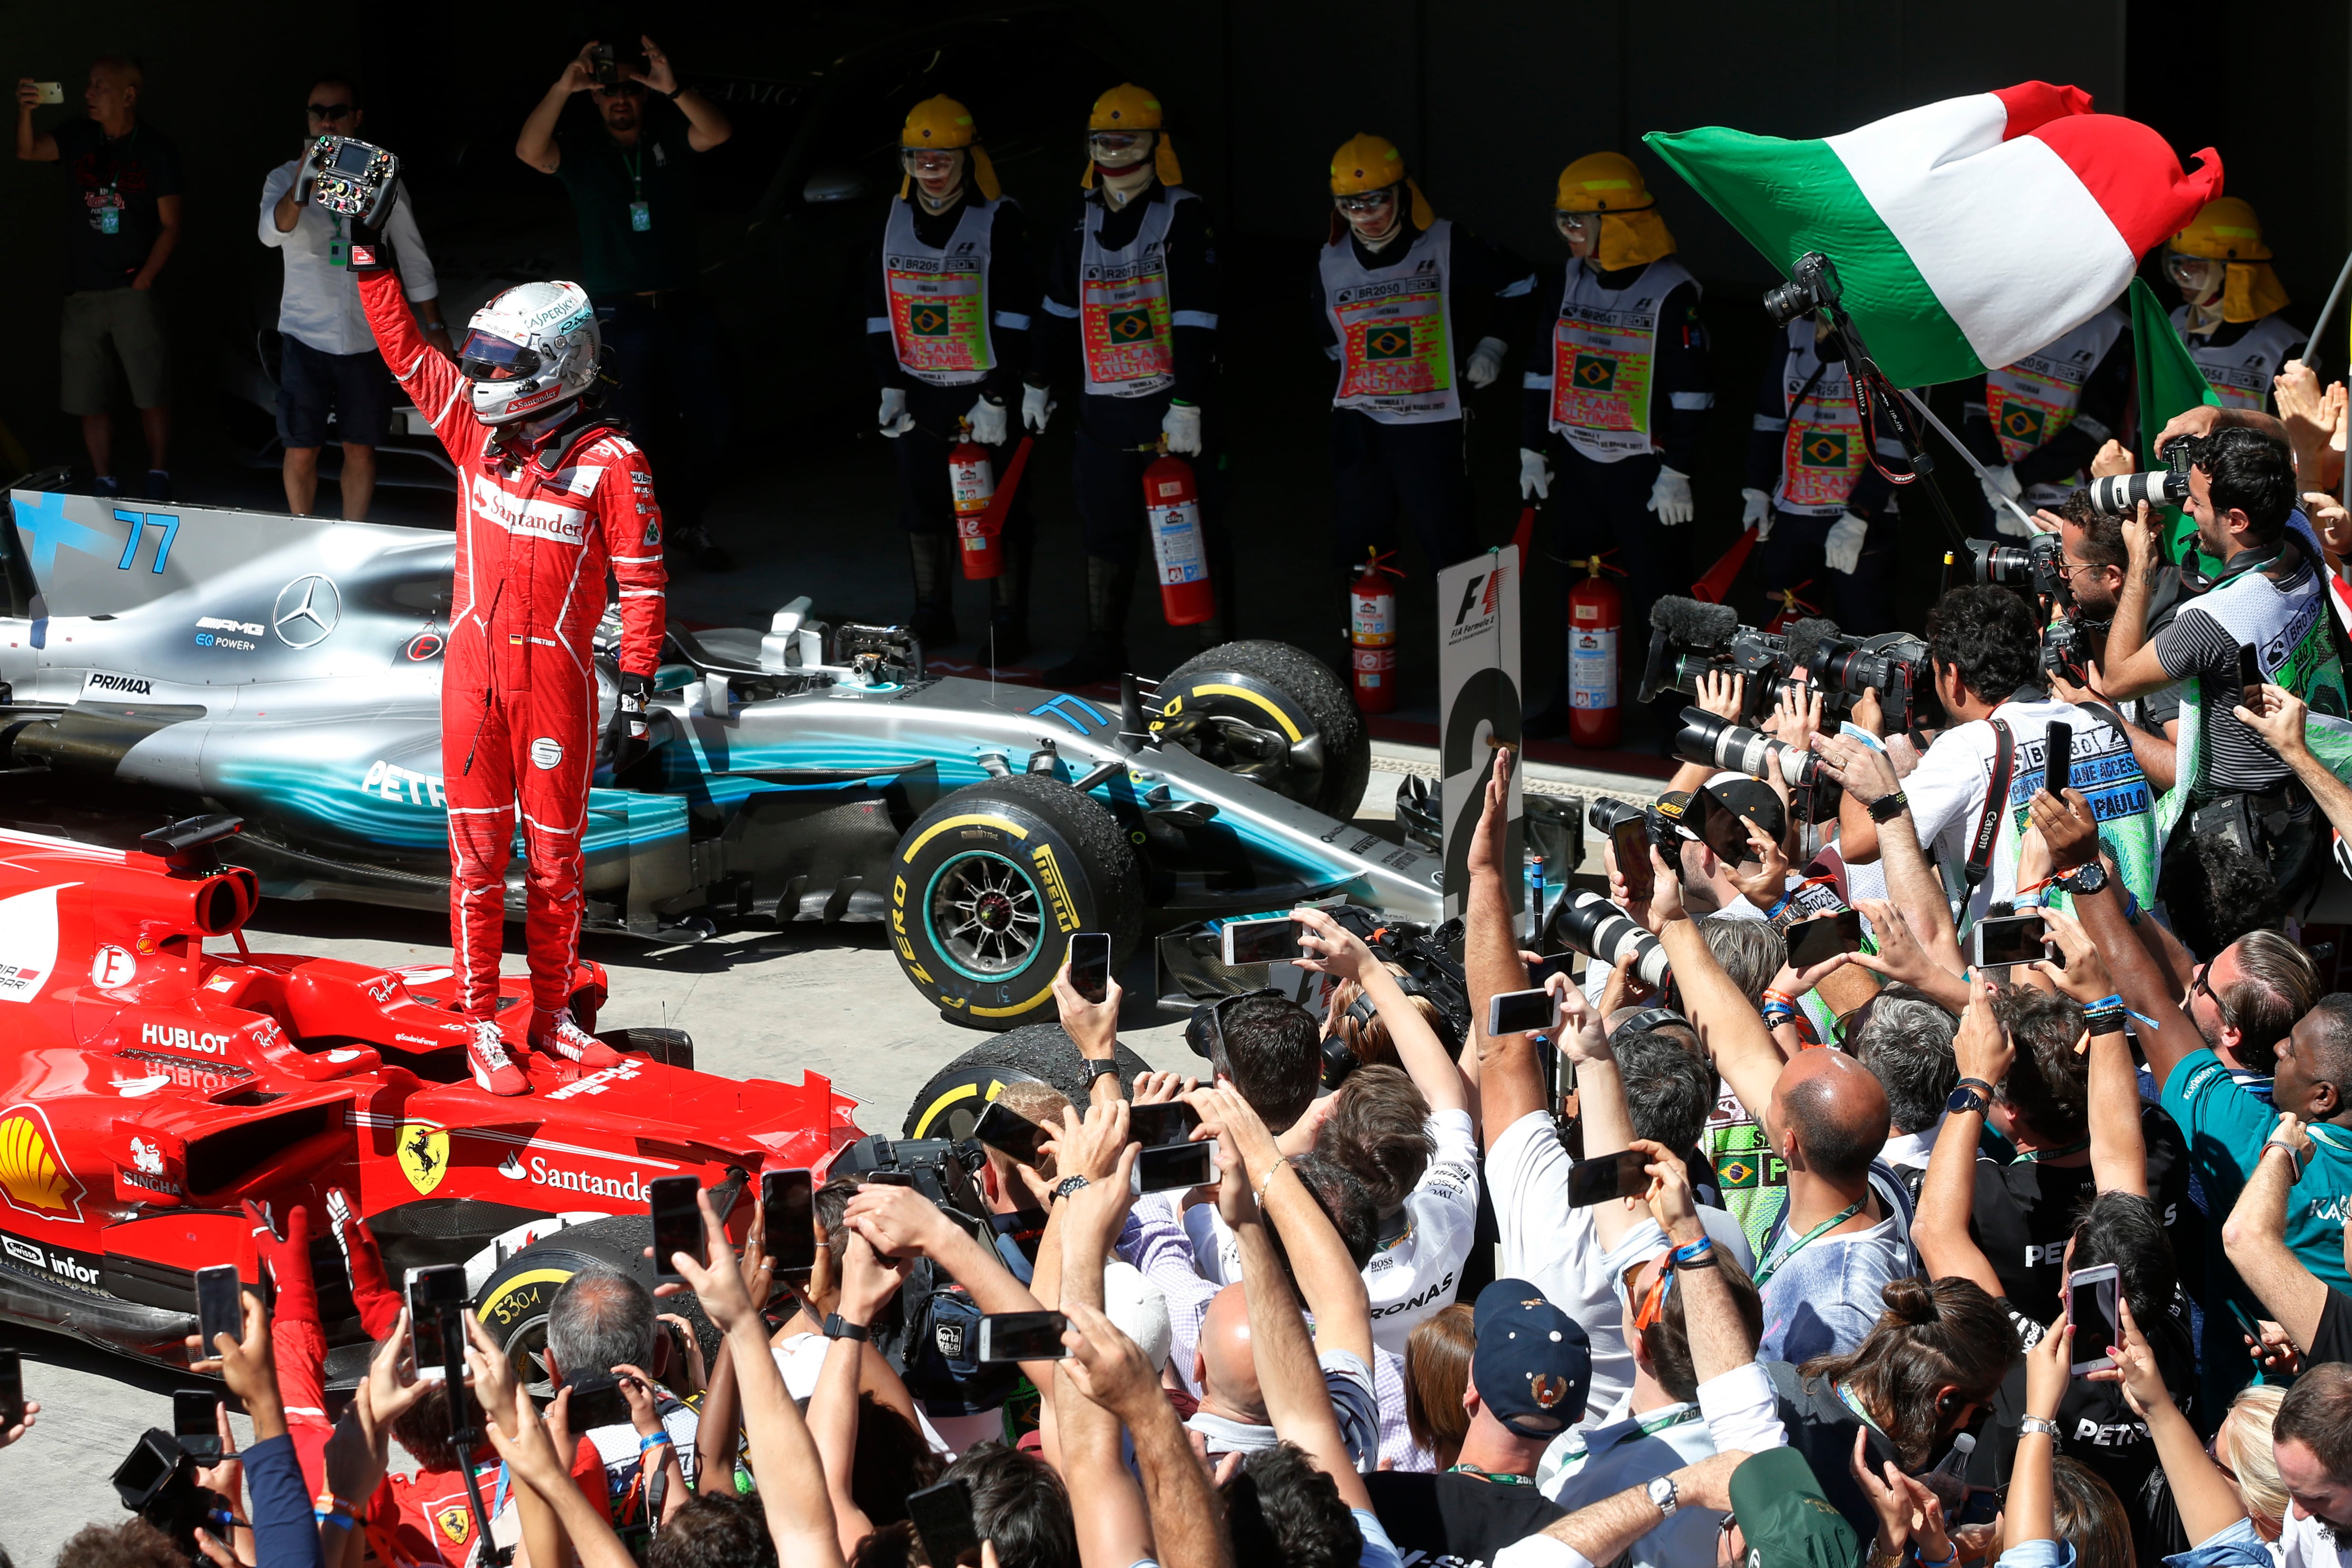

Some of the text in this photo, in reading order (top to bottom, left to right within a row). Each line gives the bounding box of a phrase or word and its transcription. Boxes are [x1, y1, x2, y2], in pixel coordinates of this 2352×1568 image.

[1107, 266, 1136, 279] R2057
[1359, 285, 1399, 298] BR2050
[486, 323, 510, 335] HUBLOT
[518, 390, 557, 409] Santander
[490, 504, 582, 538] Santander
[114, 509, 180, 574] 77
[1451, 616, 1495, 638] FIA Formula 1
[195, 633, 214, 646] EQ
[413, 637, 437, 658] E
[89, 673, 151, 695] PRIMAX
[2072, 763, 2098, 784] ANE
[2093, 789, 2148, 820] PAULO
[1978, 811, 1996, 849] Canon
[1349, 836, 1380, 855] PIRELLI
[1031, 843, 1081, 932] PIRELLI
[892, 874, 934, 985] ZERO
[105, 951, 123, 984] E
[2101, 998, 2116, 1006] LOUNGE
[142, 1023, 230, 1056] HUBLOT
[123, 1171, 182, 1196] SINGHA
[413, 1176, 437, 1186] S F
[1427, 1178, 1462, 1194] EPSON
[1430, 1188, 1452, 1198] IWC
[9, 1242, 38, 1261] Swisse
[1682, 1241, 1704, 1256] PREMIUM
[49, 1252, 100, 1285] infor
[1371, 1256, 1393, 1270] BOSS
[1773, 1252, 1789, 1270] 2017
[494, 1286, 541, 1325] 5301
[939, 1331, 958, 1342] porta
[2021, 1320, 2040, 1355] EPSON
